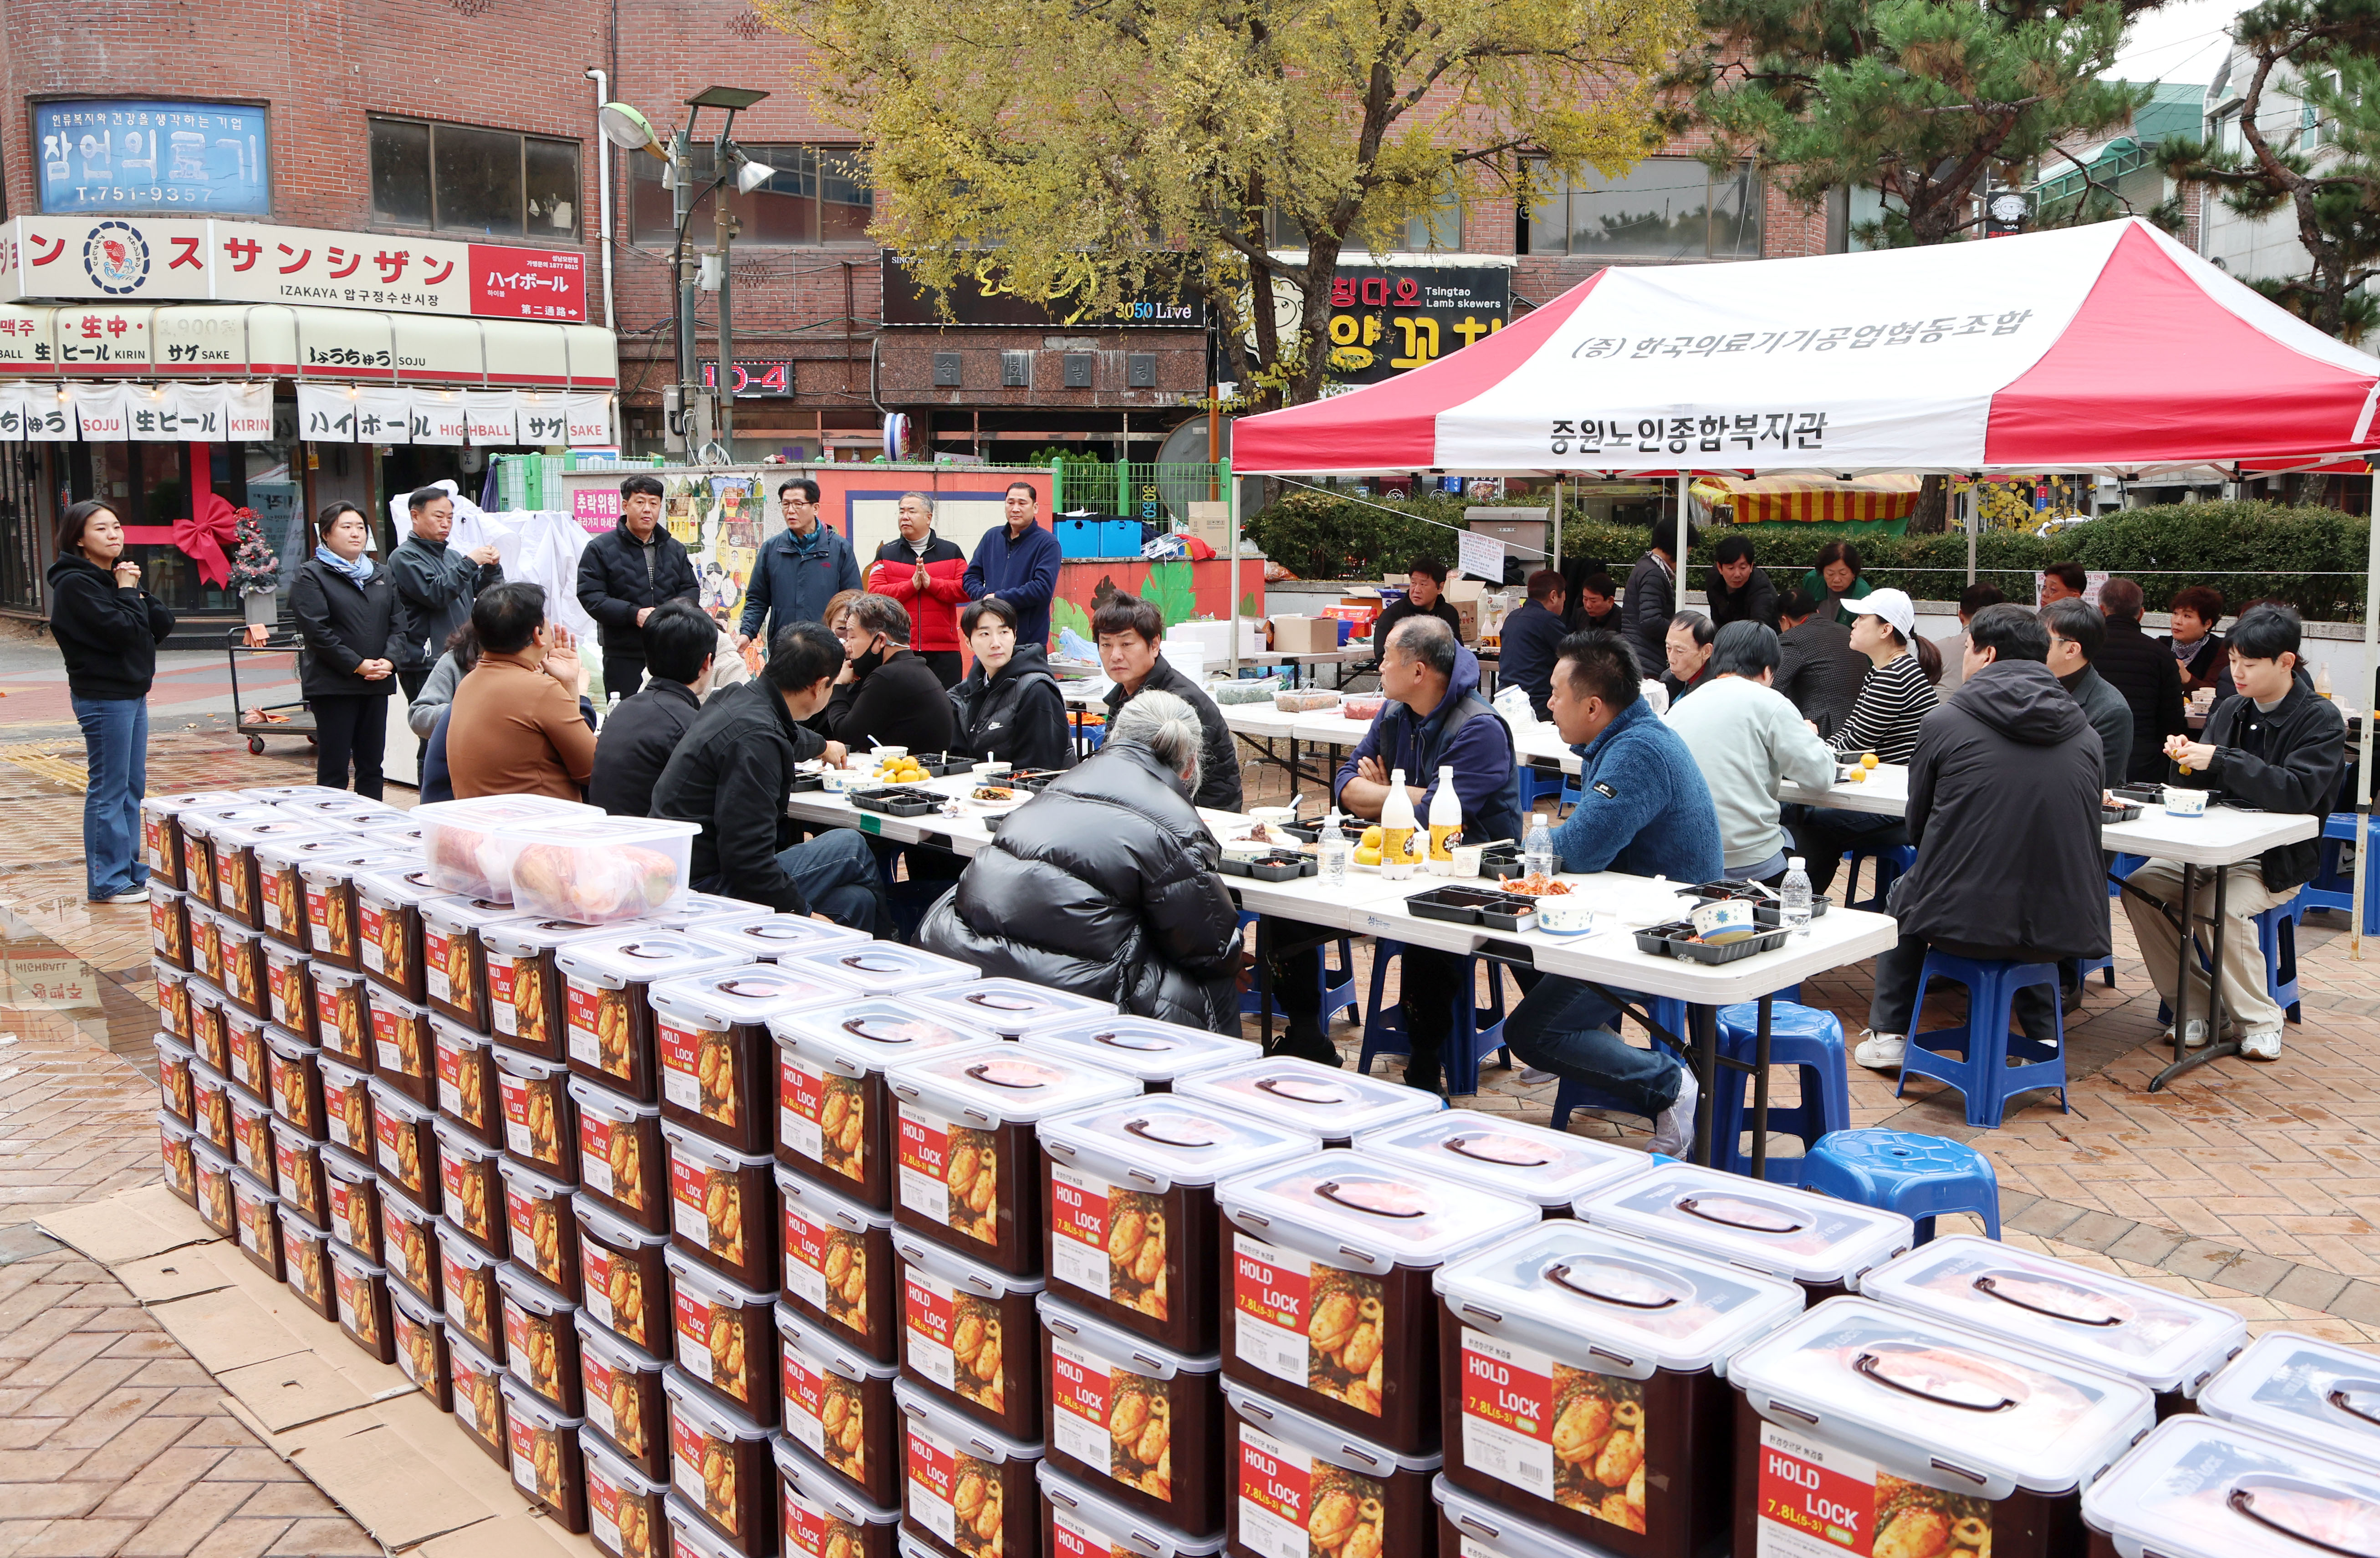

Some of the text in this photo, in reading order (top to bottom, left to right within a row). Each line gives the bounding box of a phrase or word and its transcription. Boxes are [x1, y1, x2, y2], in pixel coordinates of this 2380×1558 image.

[52, 112, 242, 131] 인류복지와 건강을 생각하는 기업
[526, 260, 548, 269] 가맹문의
[552, 255, 578, 263] 성남모란점
[487, 272, 569, 292] ハイボール
[1331, 277, 1421, 307] 칭다오
[1425, 287, 1471, 297] Tsingtao
[281, 285, 439, 307] IZAKAYA 압구정수산시장
[487, 289, 505, 297] 하이볼
[1426, 297, 1501, 308] Lamb skewers
[521, 303, 567, 318] 第二通路
[1156, 303, 1192, 320] Live
[1572, 309, 2033, 359] (증) 한국의료기기공업협동조합
[115, 350, 145, 359] KIRIN
[168, 344, 230, 361] サケ SAKE
[310, 346, 426, 366] しょうちゅう SOJU
[82, 419, 119, 431] SOJU
[136, 410, 216, 432] 生ビール
[231, 419, 269, 431] KIRIN
[310, 411, 602, 438] ハイボール HIGHBALL サケ SAKE
[1550, 412, 1828, 455] 중원노인종합복지관
[577, 493, 617, 514] 추락위험
[1143, 485, 1156, 518] 3050
[577, 517, 617, 527] 올라가지 마세요
[490, 967, 500, 978] HOLD
[498, 981, 510, 992] LOCK
[570, 990, 583, 1004] HOLD
[374, 1012, 385, 1022] HOLD
[580, 1007, 594, 1021] LOCK
[383, 1025, 394, 1034] LOCK
[662, 1029, 679, 1044] HOLD
[675, 1047, 694, 1062] LOCK
[784, 1068, 802, 1086] HOLD
[502, 1086, 513, 1100] HOLD
[797, 1090, 816, 1109] LOCK
[511, 1102, 524, 1114] LOCK
[583, 1118, 596, 1133] HOLD
[903, 1122, 924, 1142] HOLD
[593, 1135, 606, 1150] LOCK
[919, 1145, 941, 1166] LOCK
[674, 1163, 689, 1179] HOLD
[686, 1183, 702, 1200] LOCK
[1057, 1186, 1081, 1207] HOLD
[510, 1196, 521, 1210] HOLD
[519, 1212, 530, 1227] LOCK
[789, 1216, 806, 1235] HOLD
[1057, 1218, 1084, 1238] 7.8L(5-3)
[1075, 1210, 1101, 1233] LOCK
[802, 1238, 820, 1258] LOCK
[1240, 1259, 1272, 1284] HOLD
[678, 1296, 693, 1313] HOLD
[909, 1286, 930, 1307] HOLD
[1240, 1295, 1274, 1318] 7.8L(5-3)
[1264, 1288, 1299, 1314] LOCK
[689, 1316, 705, 1334] LOCK
[924, 1310, 946, 1332] LOCK
[585, 1358, 598, 1375] HOLD
[787, 1361, 804, 1381] HOLD
[1057, 1360, 1083, 1383] HOLD
[1470, 1356, 1509, 1385] HOLD
[595, 1376, 608, 1394] LOCK
[800, 1384, 817, 1405] LOCK
[1057, 1392, 1085, 1413] 7.8L(5-3)
[1077, 1386, 1102, 1410] LOCK
[1500, 1389, 1540, 1420] LOCK
[1470, 1397, 1512, 1423] 7.8L(5-3)
[675, 1418, 689, 1438] HOLD
[685, 1441, 700, 1462] LOCK
[912, 1438, 932, 1461] HOLD
[1246, 1449, 1276, 1476] HOLD
[1769, 1455, 1819, 1489] HOLD
[591, 1475, 603, 1493] HOLD
[927, 1464, 948, 1487] LOCK
[601, 1495, 615, 1513] LOCK
[1245, 1483, 1278, 1509] 7.8L(5-3)
[1268, 1480, 1300, 1508] LOCK
[787, 1501, 802, 1522] HOLD
[1768, 1498, 1822, 1532] 7.8L(5-3)
[1807, 1494, 1858, 1530] LOCK
[798, 1525, 820, 1546] LOCK
[1059, 1530, 1084, 1554] HOLD
